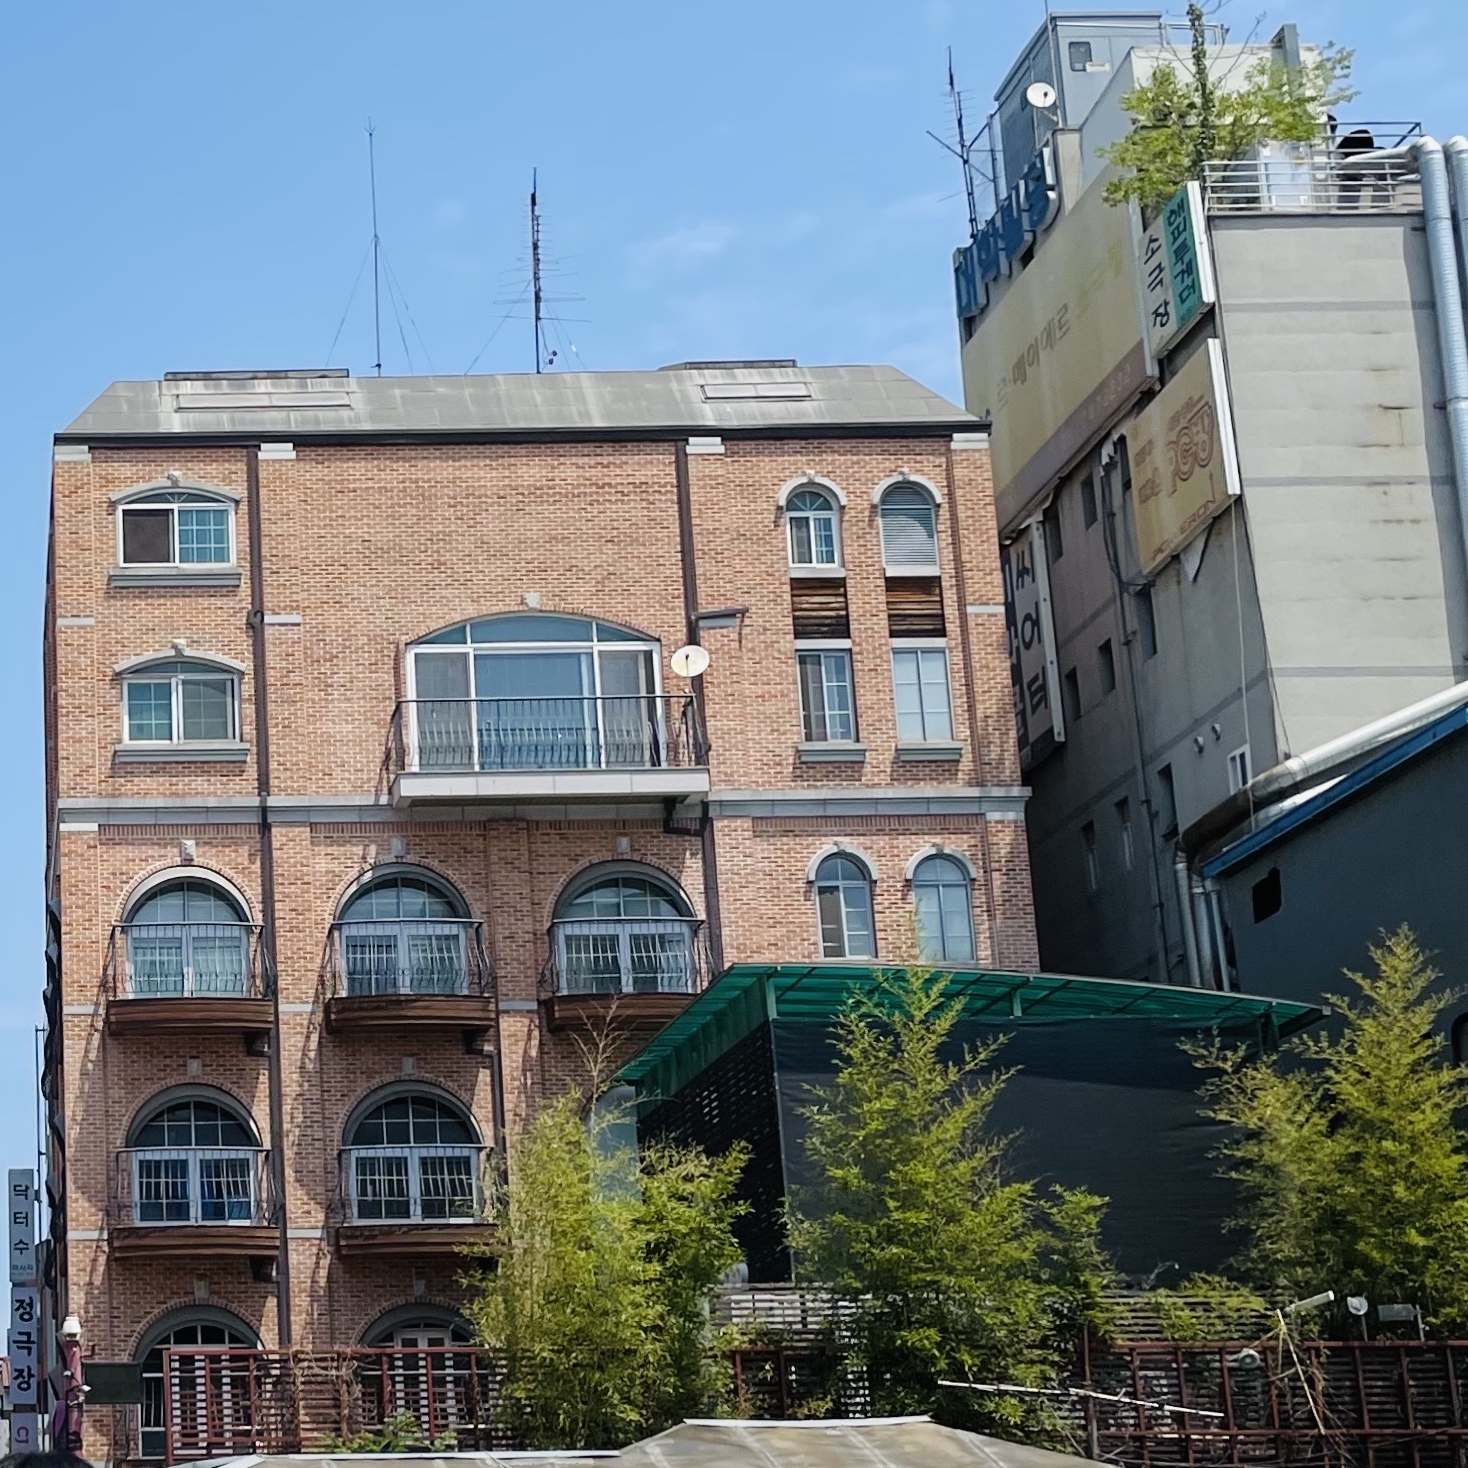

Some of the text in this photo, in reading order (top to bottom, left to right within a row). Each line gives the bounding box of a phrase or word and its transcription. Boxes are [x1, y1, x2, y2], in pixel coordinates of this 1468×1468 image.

[1143, 233, 1170, 328] 소극장
[1167, 199, 1196, 305] 해피투게더
[1016, 540, 1048, 717] 씨어터
[13, 1183, 30, 1255] 닥터수
[12, 1296, 36, 1392] 정극장
